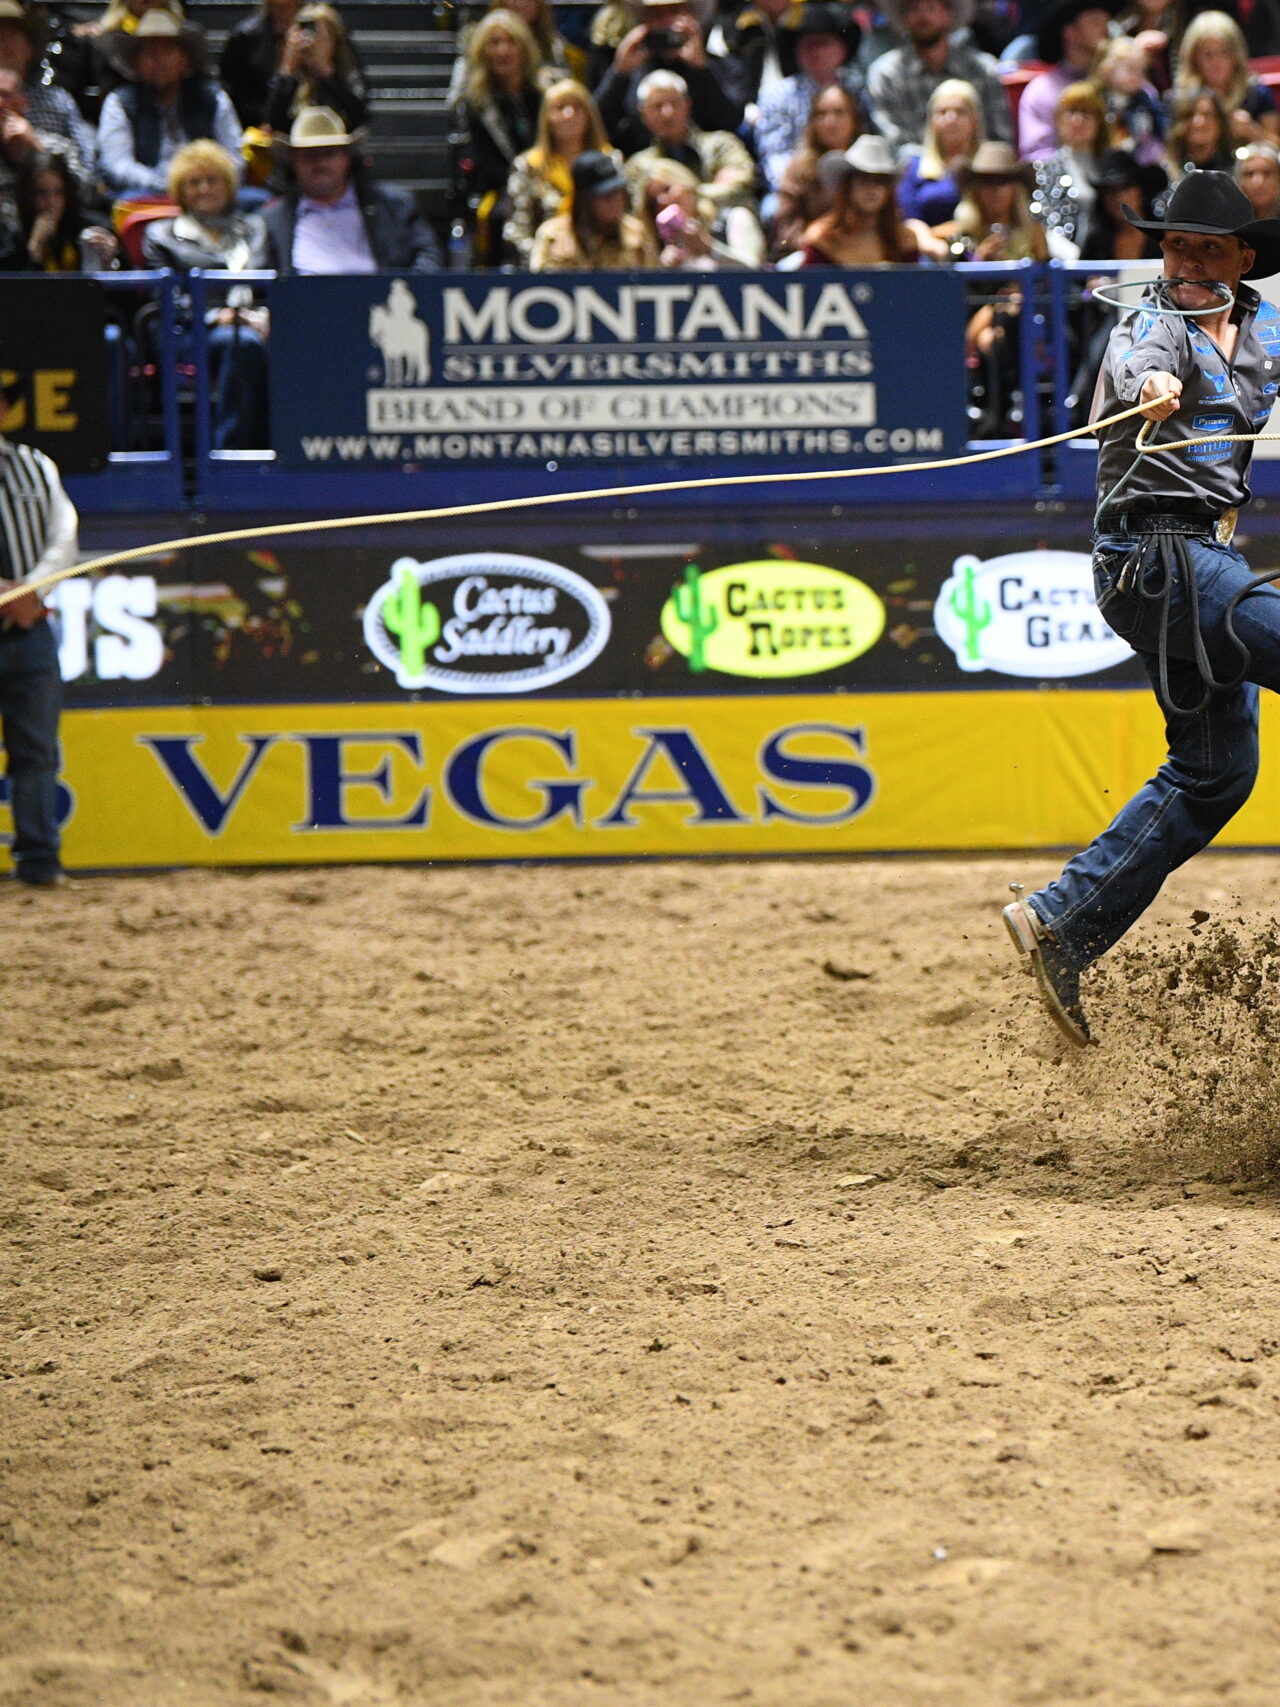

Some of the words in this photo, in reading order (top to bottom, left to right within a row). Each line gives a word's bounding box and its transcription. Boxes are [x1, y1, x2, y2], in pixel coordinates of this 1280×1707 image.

[442, 283, 868, 344] MONTANA
[442, 350, 874, 383] SILVERSMITHS
[376, 392, 526, 424] BRAND
[537, 391, 597, 421] OF
[609, 386, 858, 421] CHAMPIONS
[300, 427, 944, 461] WWW.MONTANASILVERSMITHS.COM
[453, 575, 558, 623] Cactus
[433, 614, 572, 669] Saddlery
[135, 723, 877, 839] VEGAS
